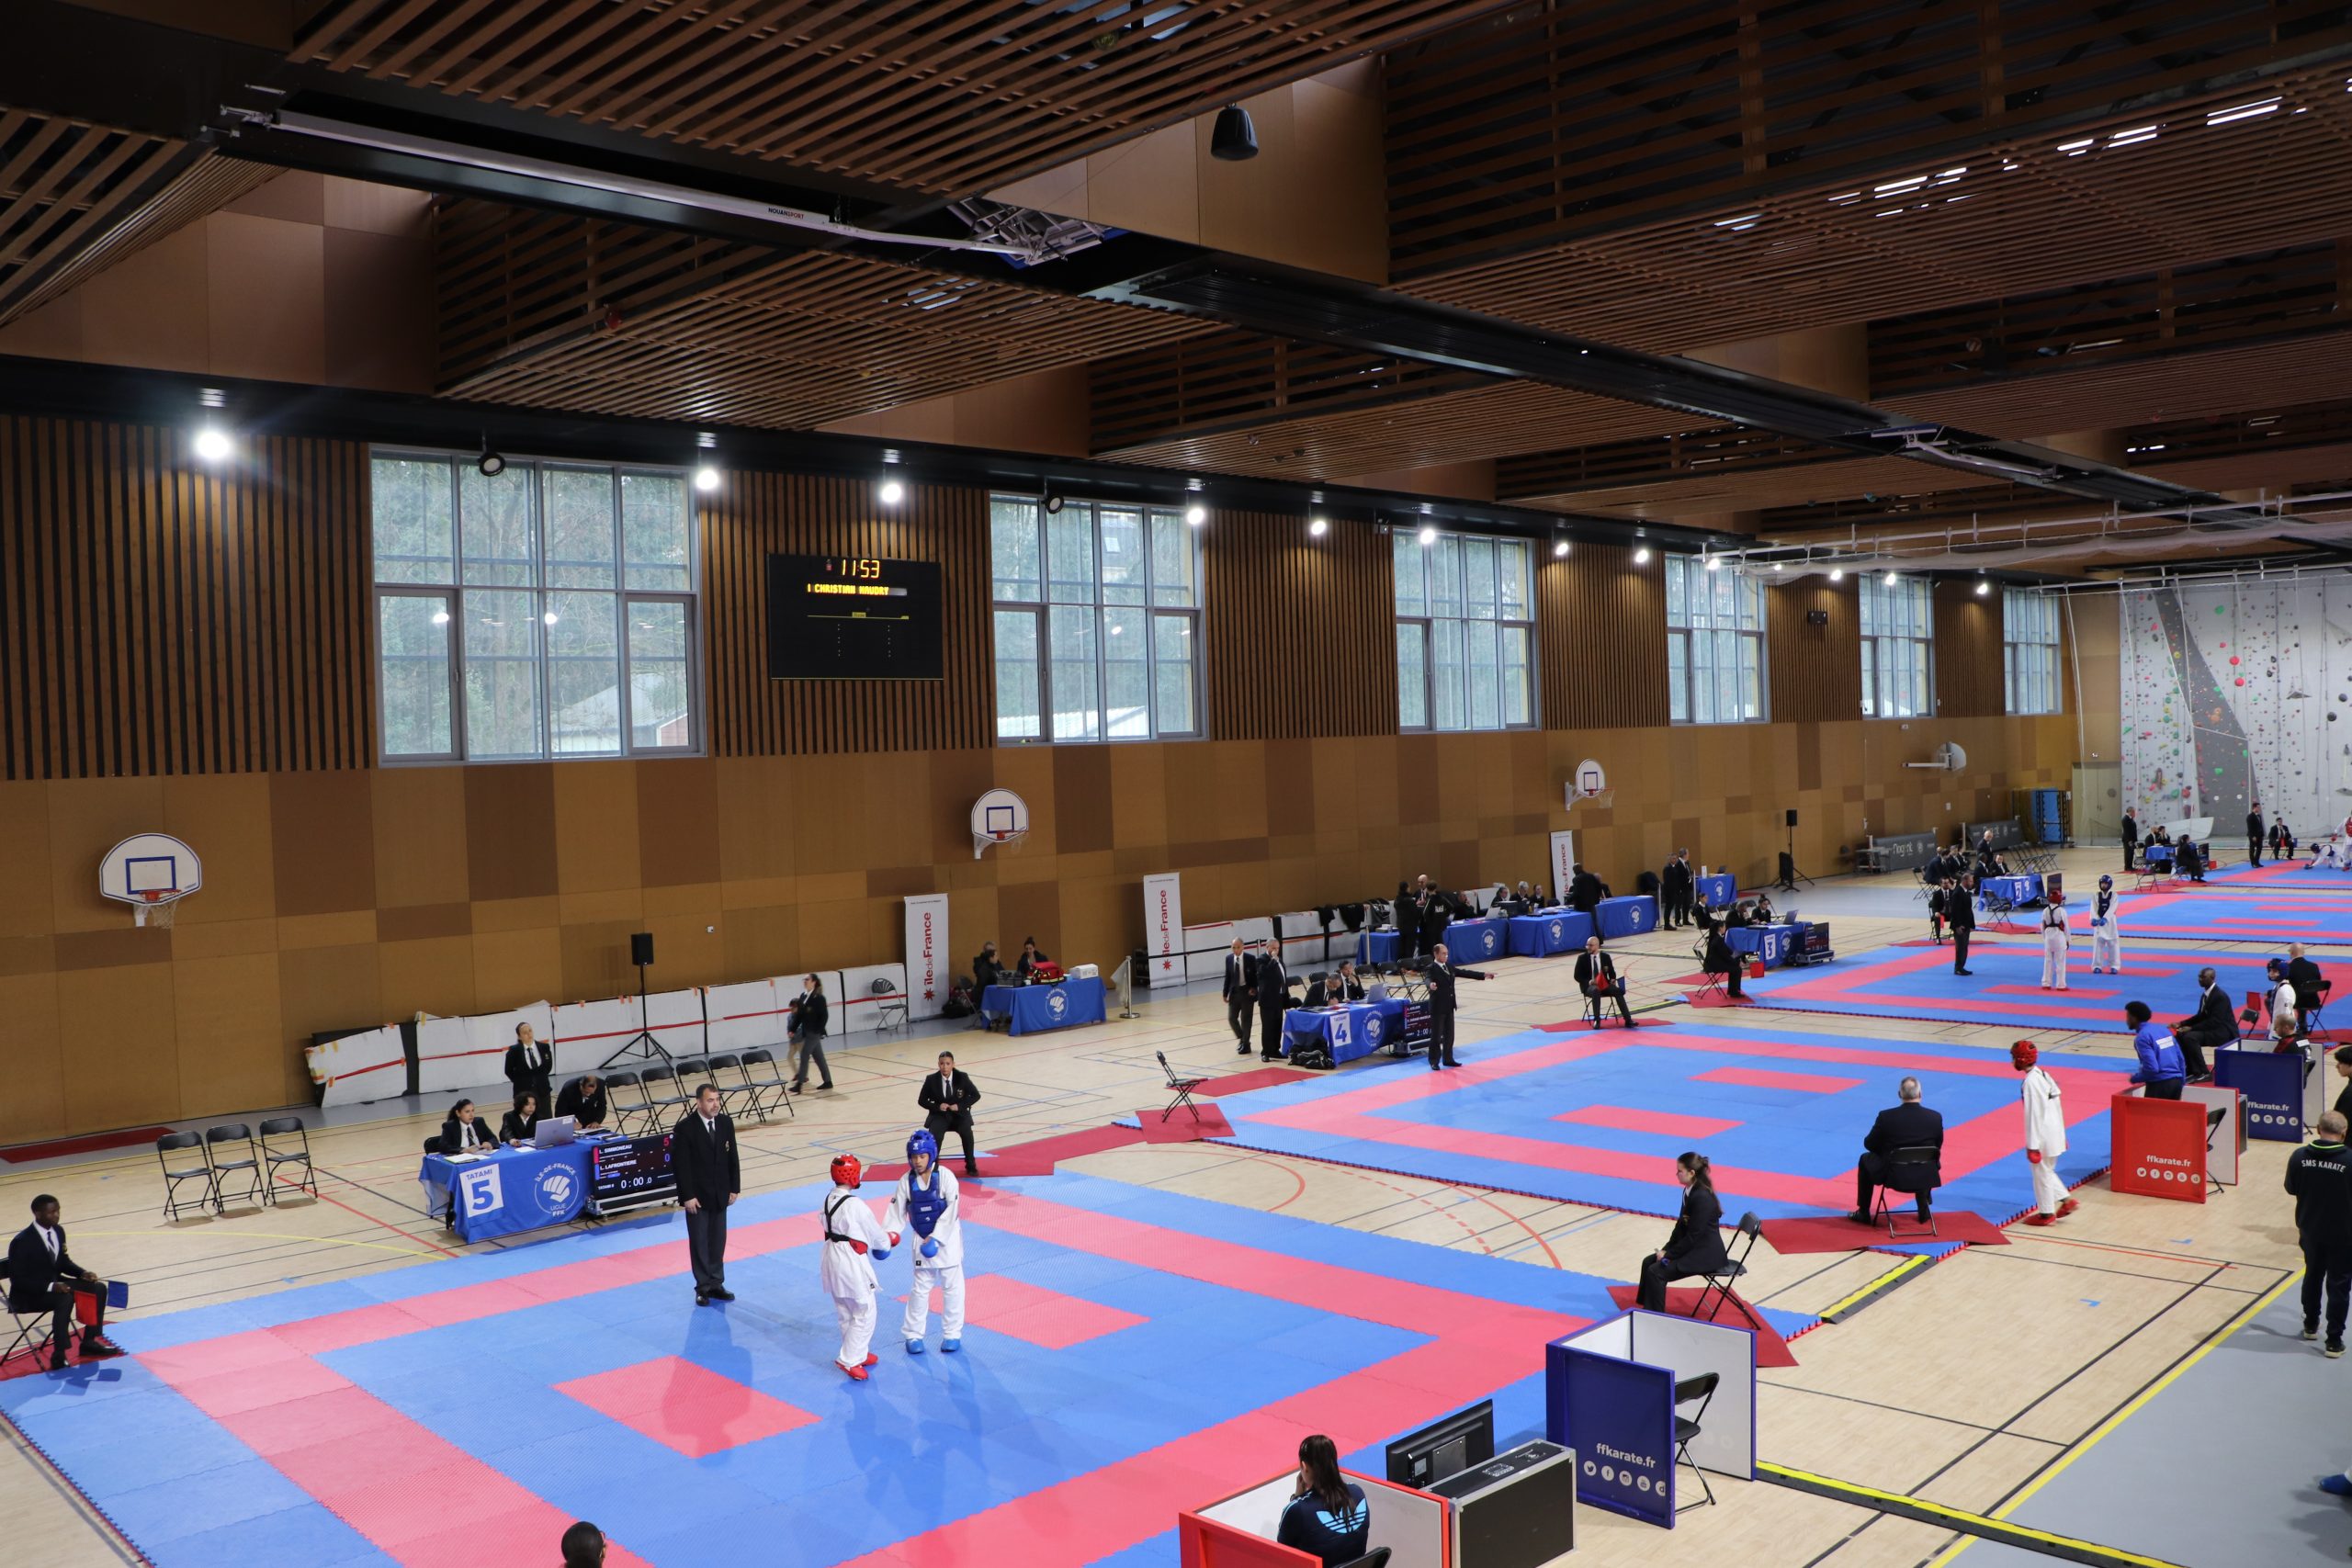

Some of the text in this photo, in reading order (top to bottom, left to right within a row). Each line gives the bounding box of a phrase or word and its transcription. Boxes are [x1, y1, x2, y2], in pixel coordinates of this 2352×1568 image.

[768, 208, 804, 220] NOUANSPORT
[842, 558, 880, 579] 11:53
[815, 583, 856, 594] CHRISTIAN
[1767, 941, 1773, 957] 3
[1335, 1022, 1348, 1043] 4
[2247, 1100, 2290, 1111] ffkarate.fr
[663, 1137, 671, 1146] 5
[664, 1153, 670, 1163] 0
[2146, 1154, 2191, 1168] ffkarate.fr
[2301, 1159, 2346, 1173] SMS KARATE
[466, 1168, 492, 1181] TATAMI
[471, 1179, 494, 1211] 5
[550, 1202, 568, 1212] LIGUE
[552, 1210, 566, 1218] FFK
[1597, 1443, 1656, 1468] ffkarate.fr
